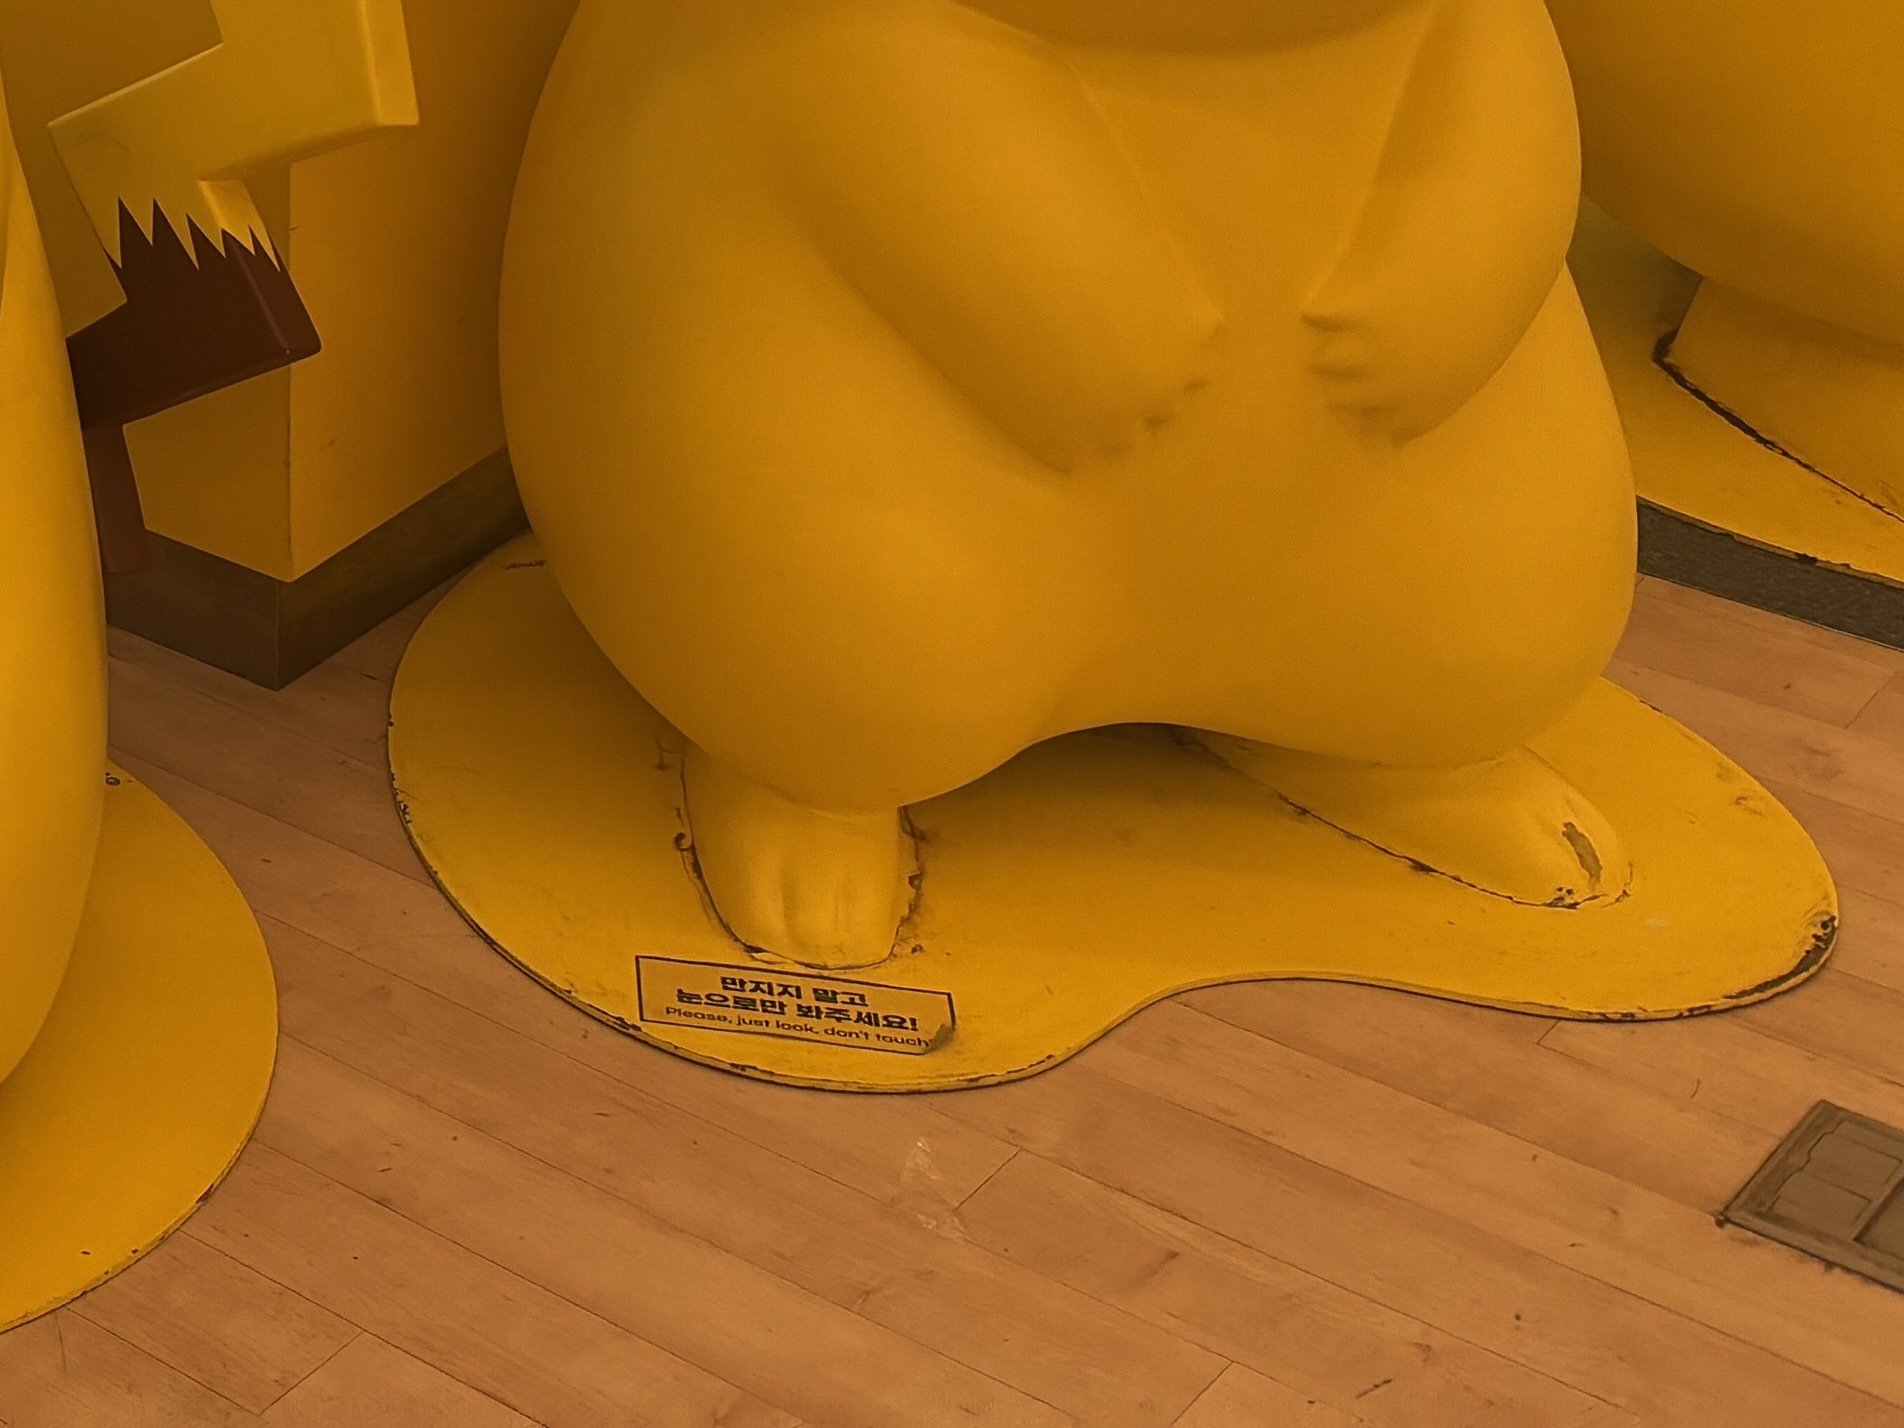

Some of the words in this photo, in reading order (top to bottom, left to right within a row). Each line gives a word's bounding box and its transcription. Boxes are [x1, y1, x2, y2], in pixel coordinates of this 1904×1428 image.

[720, 976, 802, 999] 만지지
[812, 988, 868, 1007] 말고
[677, 989, 787, 1015] 눈으로만
[796, 1004, 918, 1032] 봐주세요!
[737, 1015, 769, 1027] just
[823, 1027, 869, 1041] don't
